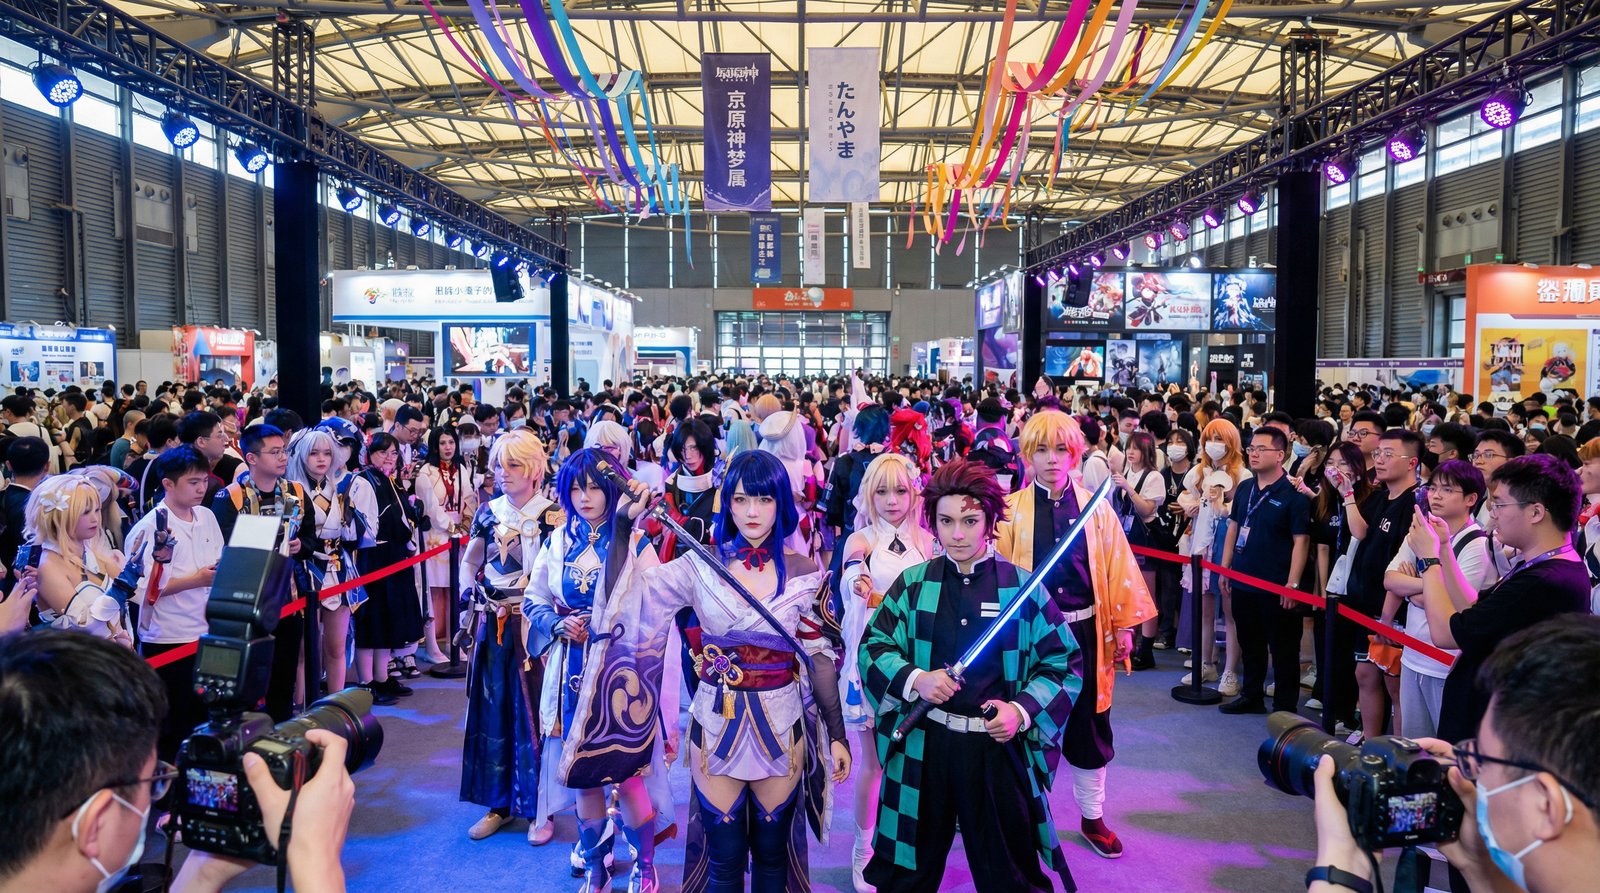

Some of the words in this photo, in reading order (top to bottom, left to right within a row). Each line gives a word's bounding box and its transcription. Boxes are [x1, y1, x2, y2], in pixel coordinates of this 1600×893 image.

[727, 90, 746, 187] 京原神梦属
[837, 81, 855, 158] たんやま
